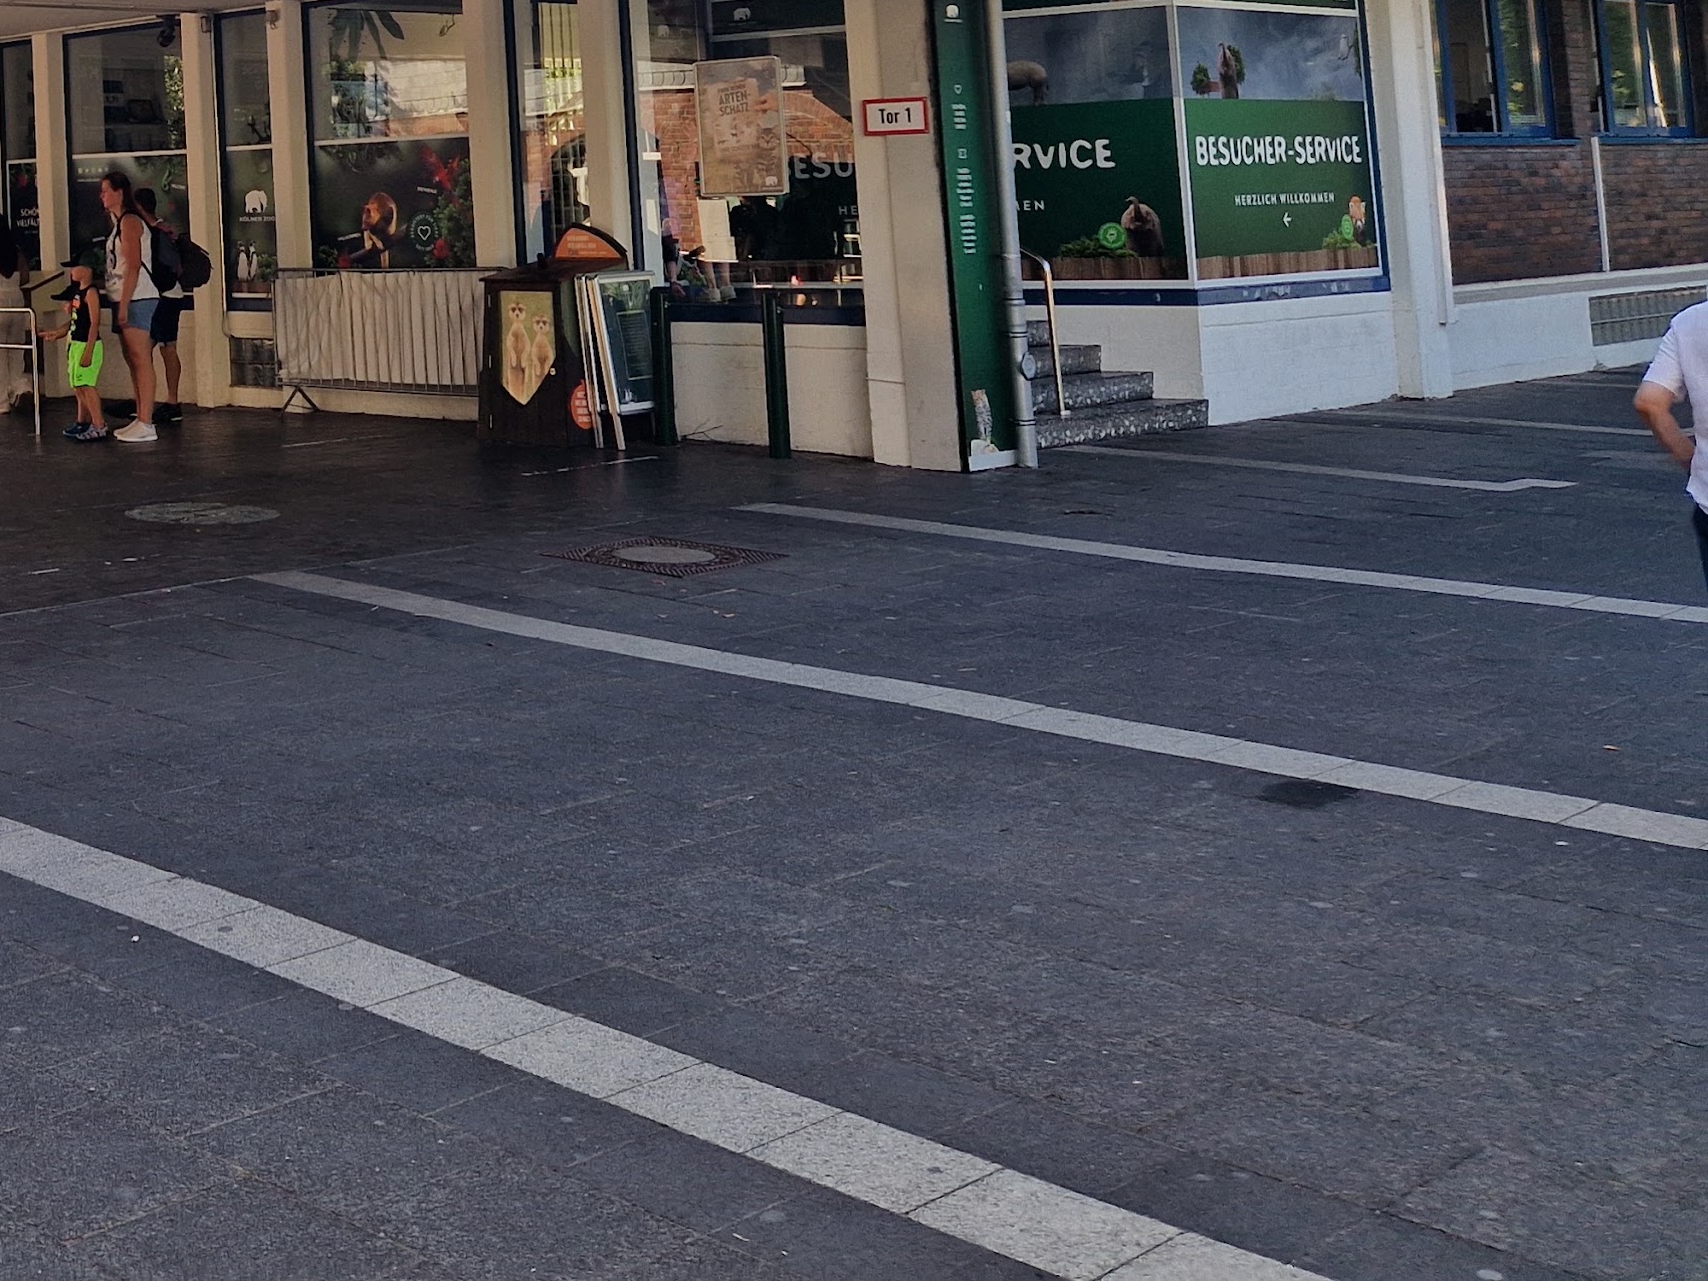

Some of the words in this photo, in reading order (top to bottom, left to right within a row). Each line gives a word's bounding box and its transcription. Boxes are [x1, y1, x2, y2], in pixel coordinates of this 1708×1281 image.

[718, 90, 752, 106] ARTEN-
[719, 101, 750, 117] SCHATZ
[878, 108, 901, 125] Tor
[905, 107, 912, 123] 1
[1195, 135, 1363, 166] BESUCHER-SERVICE
[1234, 193, 1278, 207] HERZLICH
[1279, 191, 1335, 205] WILLKOMMEN
